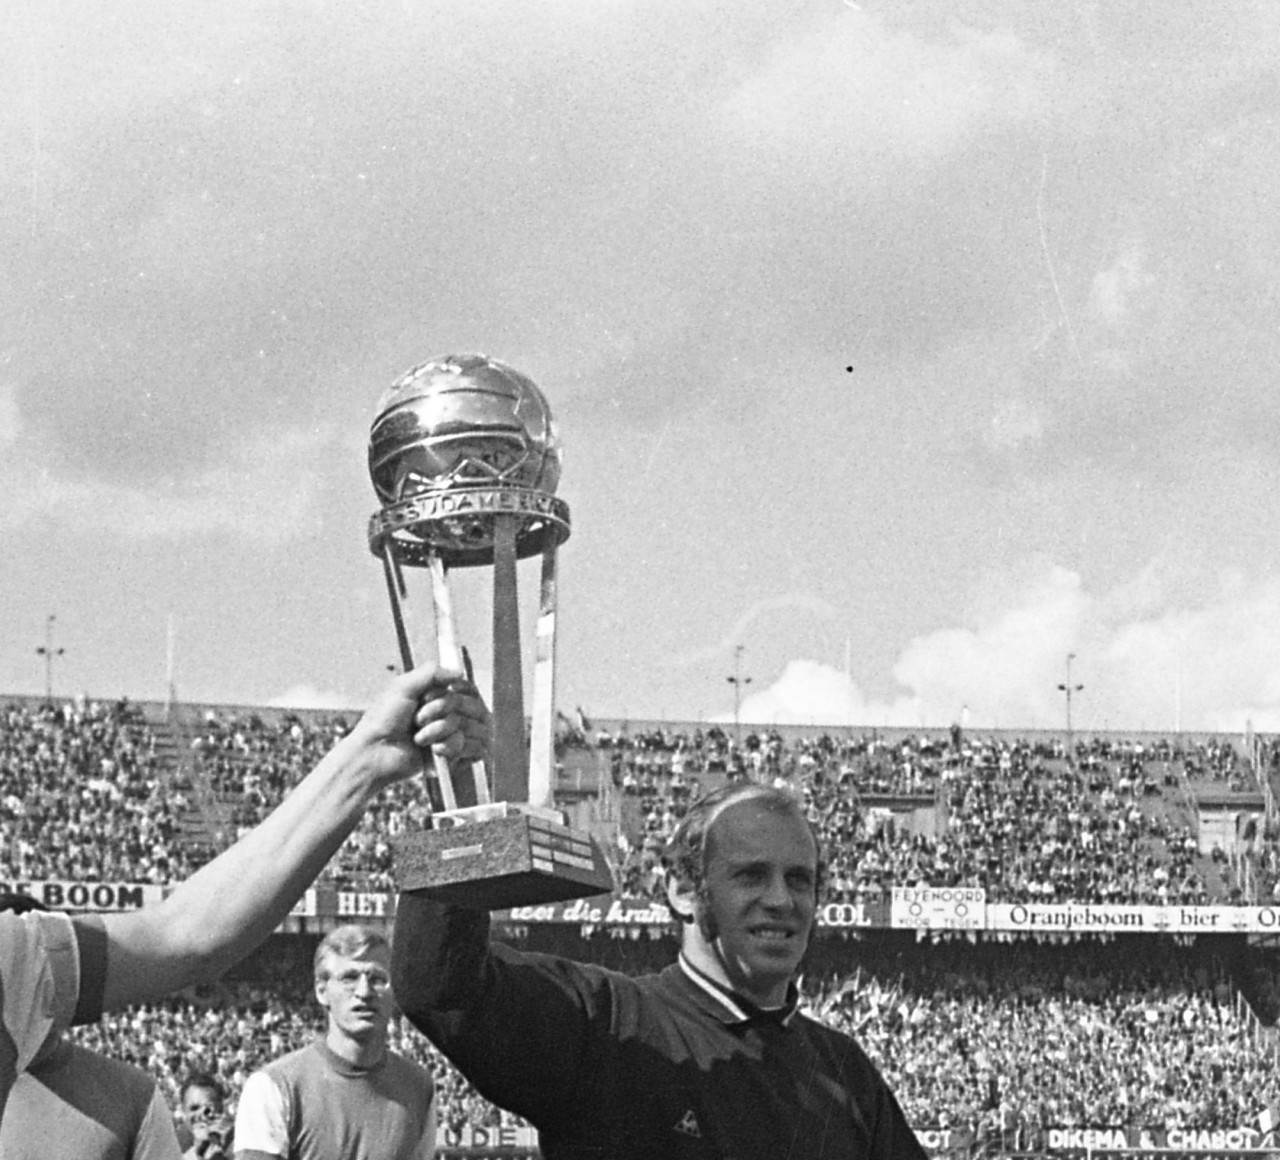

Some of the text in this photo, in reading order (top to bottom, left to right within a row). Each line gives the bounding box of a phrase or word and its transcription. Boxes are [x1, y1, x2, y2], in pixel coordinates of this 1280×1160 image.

[43, 883, 143, 908] BOOM
[337, 892, 387, 915] HET
[894, 889, 983, 902] FEYENOORD
[1009, 905, 1144, 929] Oranjeboom
[1180, 907, 1220, 926] bier
[1049, 1129, 1128, 1149] DIKEMA
[1167, 1127, 1260, 1149] CHABOT
